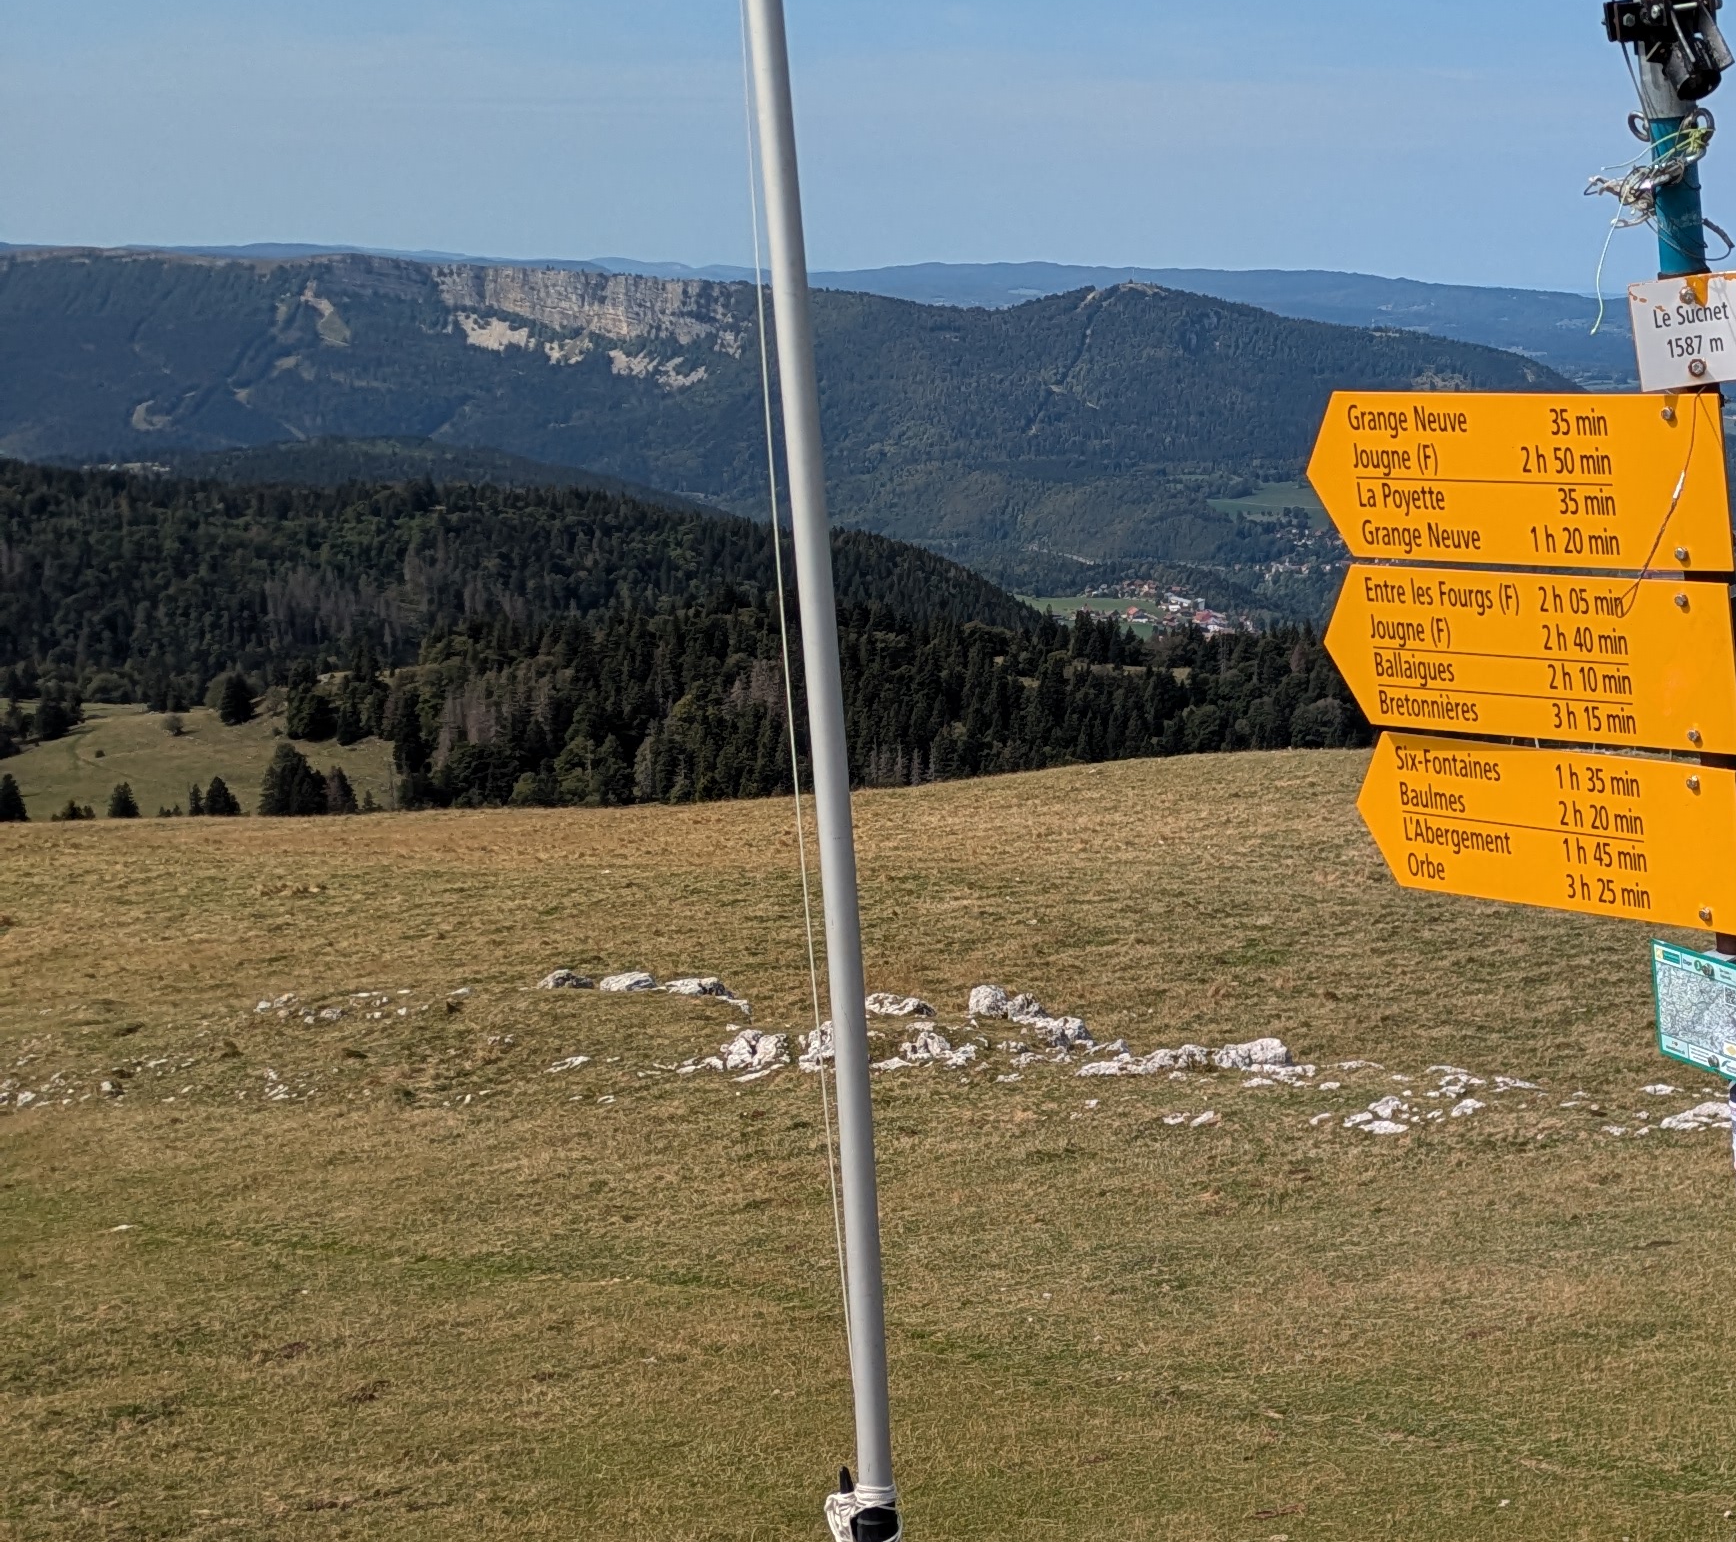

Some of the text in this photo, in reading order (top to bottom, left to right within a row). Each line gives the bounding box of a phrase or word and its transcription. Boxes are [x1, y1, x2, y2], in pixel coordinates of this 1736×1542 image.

[1653, 302, 1729, 328] Le Suchet
[1667, 335, 1723, 358] 1587 m
[1348, 405, 1607, 439] Grange Neuve 35 min
[1354, 443, 1611, 477] Jougne (F) 2 h 50 min
[1357, 482, 1616, 516] La Poyette 35 min
[1362, 520, 1620, 555] Grange Neuve 1 h 20 min
[1365, 577, 1624, 618] Entre les Fourgs (F) 2 h 05 min
[1371, 614, 1628, 655] Jougne (F) 2 h 40 min
[1374, 652, 1632, 695] Ballaigues 2 h 10 min
[1379, 690, 1636, 734] Bretonnières 3 h 15 min
[1395, 745, 1640, 797] Six-Fontaines 1 h 35 min
[1400, 782, 1643, 835] Baulmes 2 h 20 min
[1404, 817, 1647, 872] L'Abergement 1 h 45 min
[1408, 853, 1650, 909] Orbe 3 h 25 min
